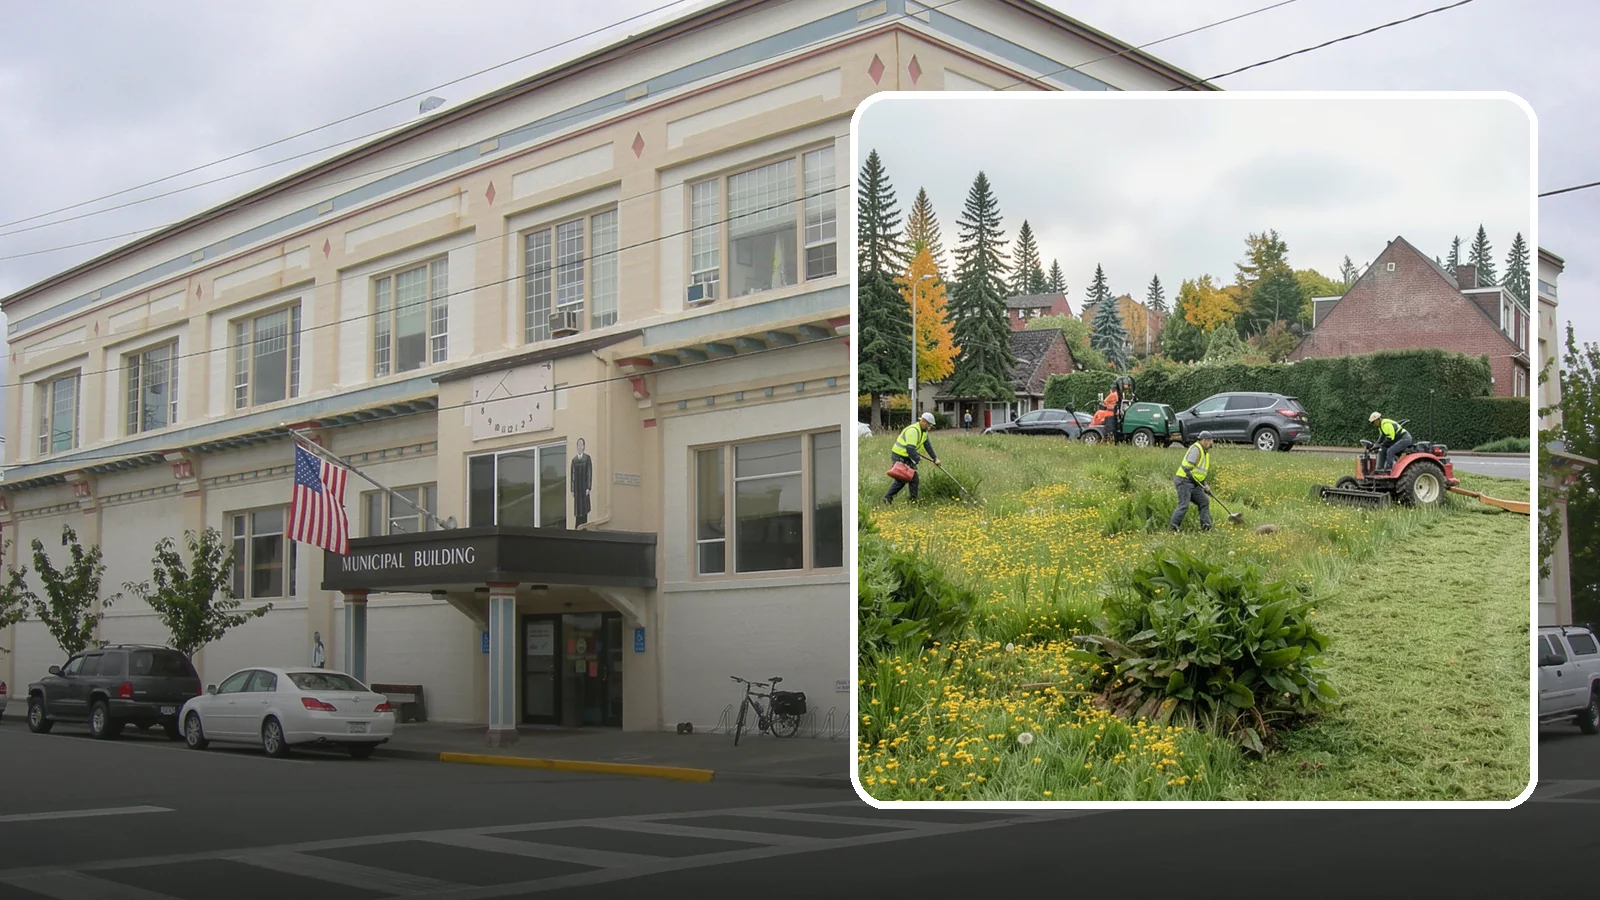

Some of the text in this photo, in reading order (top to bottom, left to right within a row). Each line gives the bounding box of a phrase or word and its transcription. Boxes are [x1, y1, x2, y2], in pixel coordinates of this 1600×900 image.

[494, 424, 500, 432] 10
[342, 546, 475, 572] MUNICIPAL BUILDING
